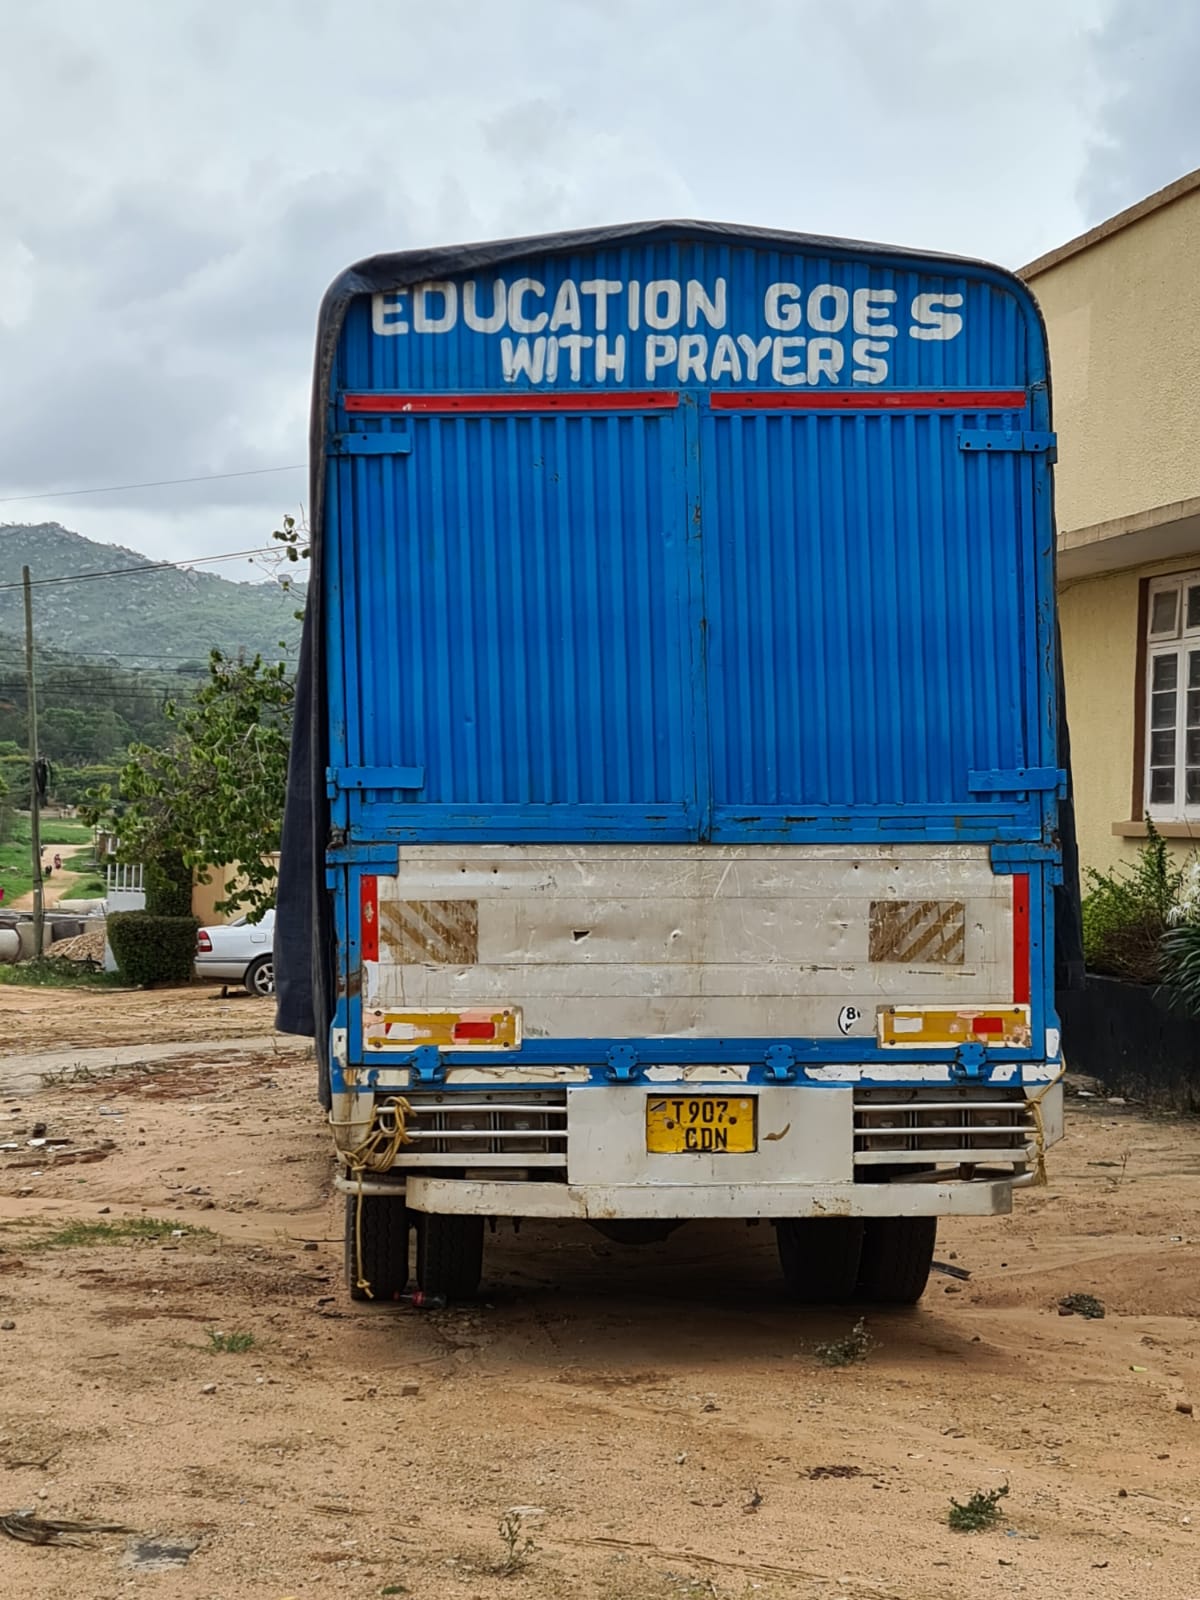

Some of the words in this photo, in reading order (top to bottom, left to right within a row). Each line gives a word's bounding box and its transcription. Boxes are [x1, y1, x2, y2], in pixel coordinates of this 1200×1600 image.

[371, 277, 727, 336] EDUCATION
[763, 282, 964, 341] GOES
[500, 334, 625, 384] WITH
[645, 334, 890, 386] PRAYERS
[685, 1127, 728, 1149] CDN
